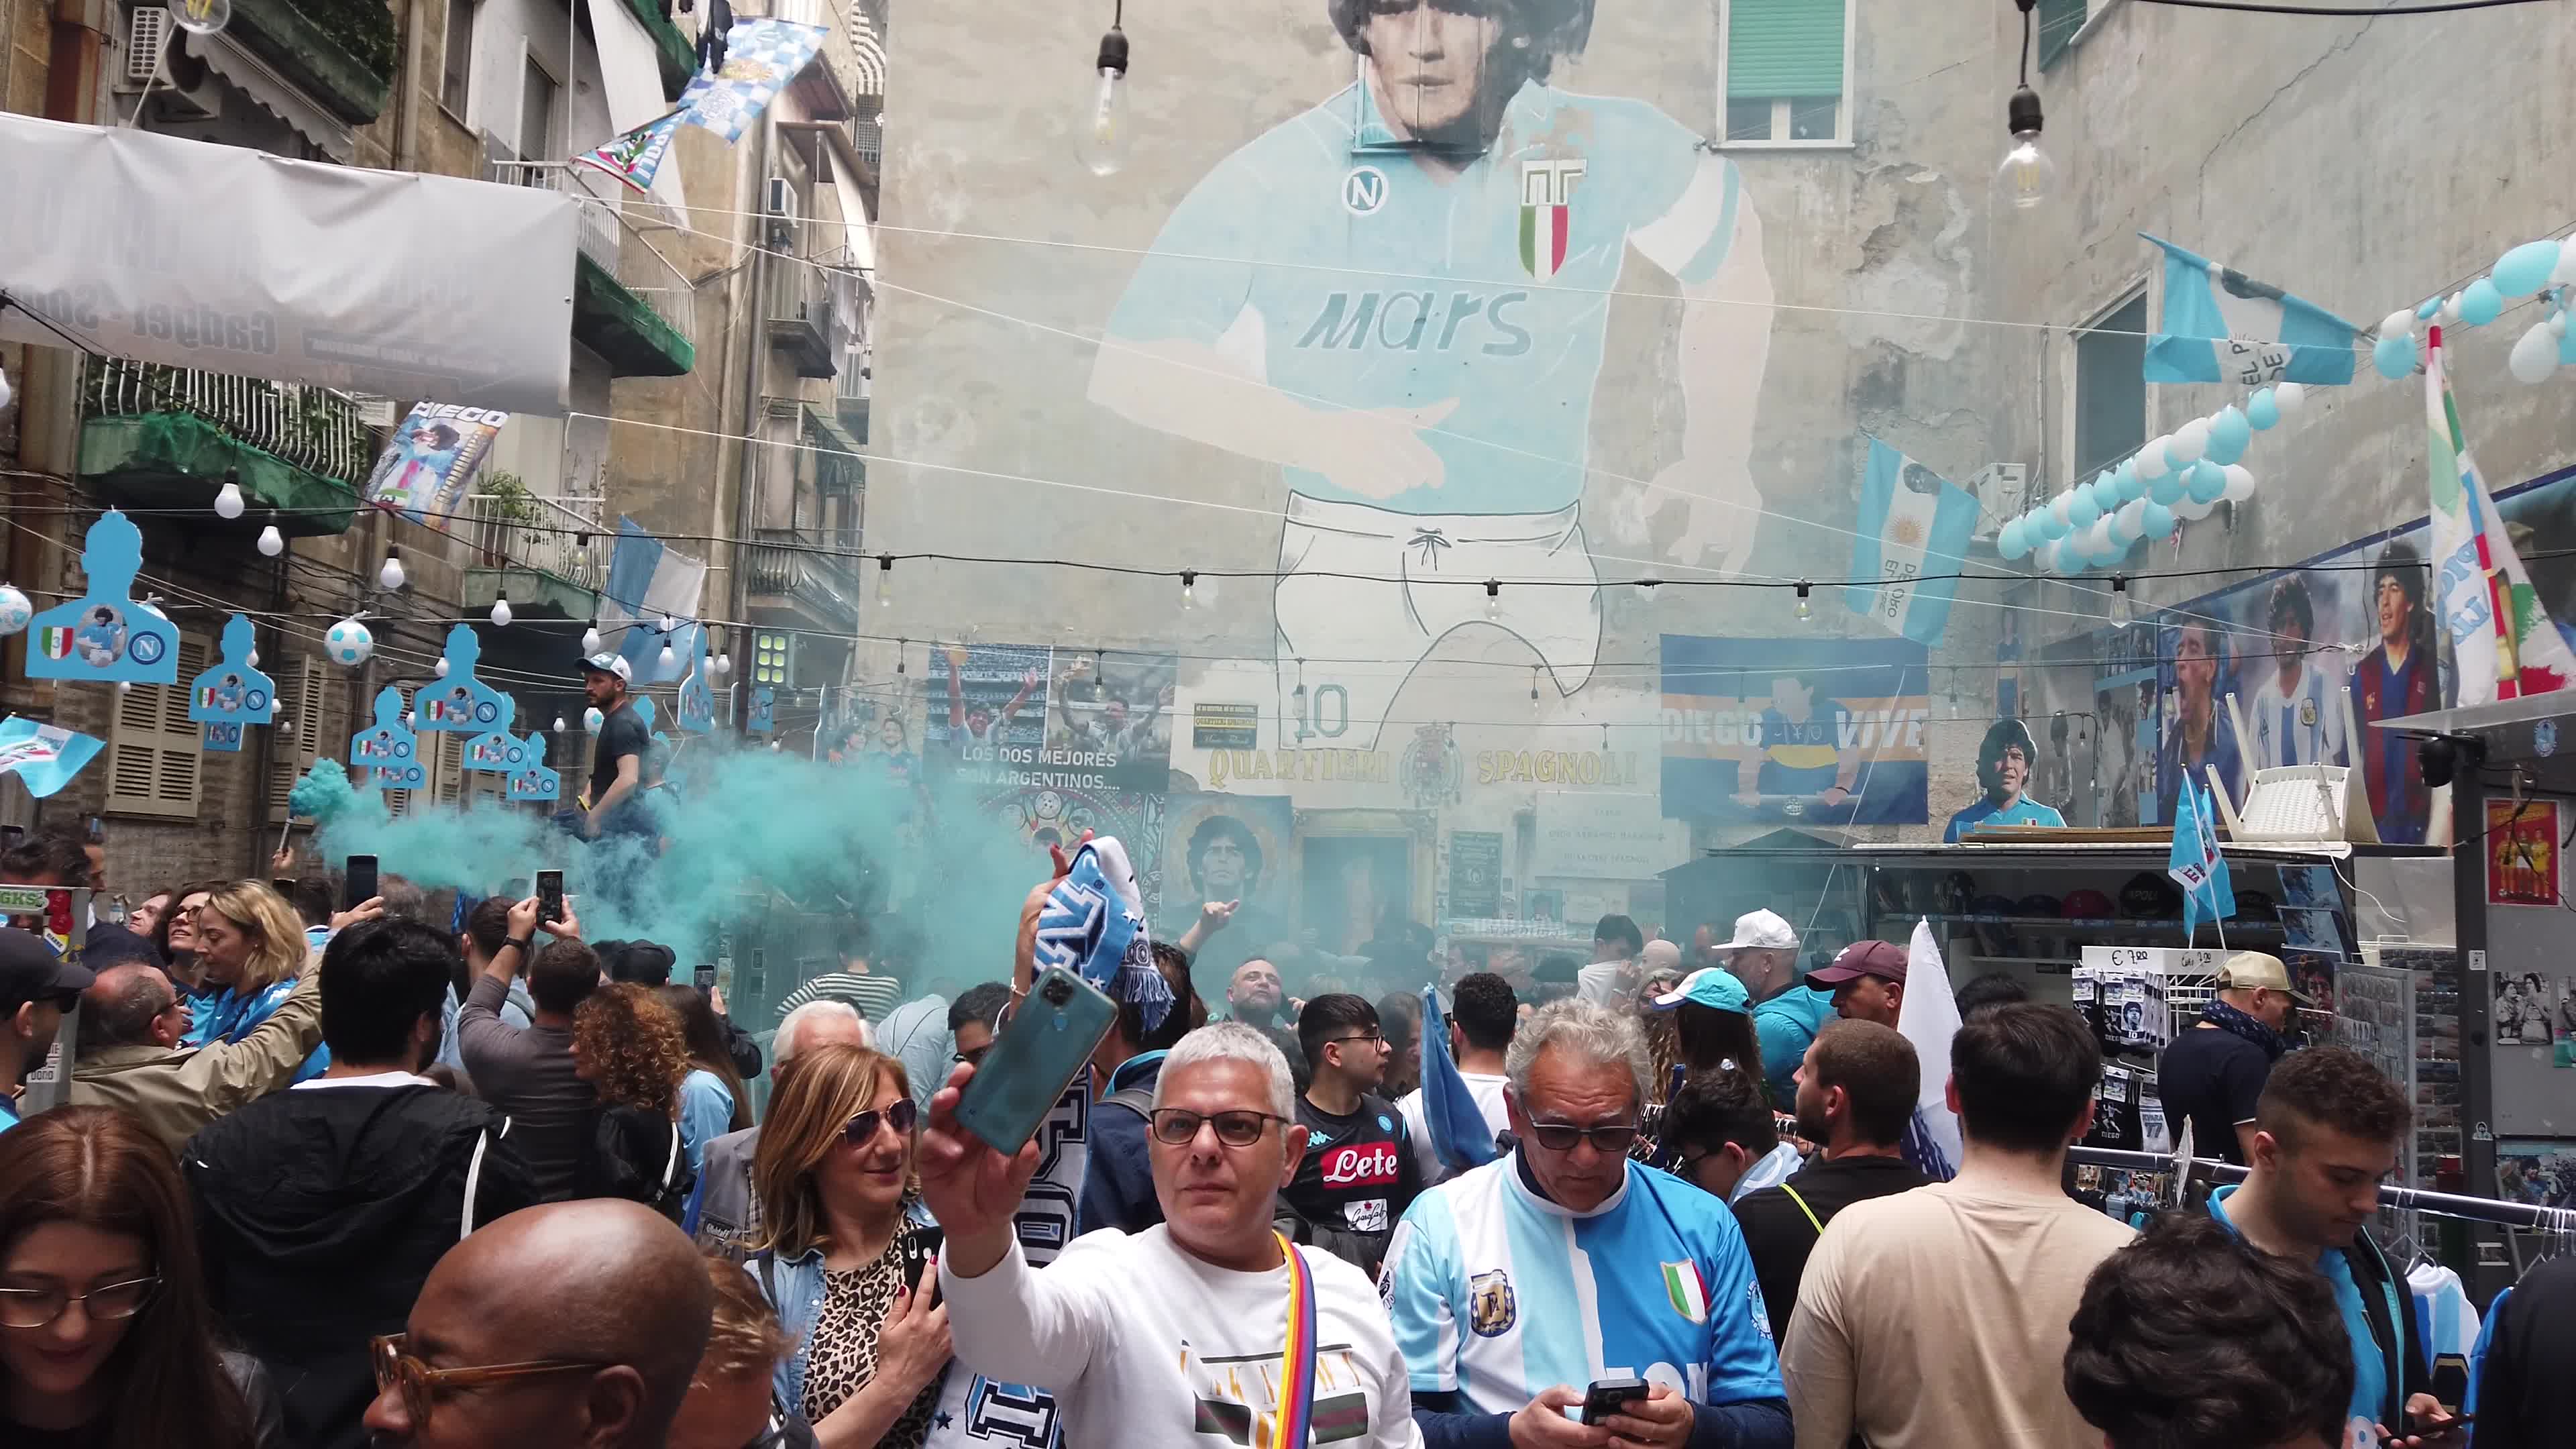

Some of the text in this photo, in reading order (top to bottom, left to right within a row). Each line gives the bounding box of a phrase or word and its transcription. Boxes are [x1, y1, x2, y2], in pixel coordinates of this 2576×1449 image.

[409, 400, 508, 428] DIEGO
[53, 636, 60, 649] 3
[138, 639, 156, 656] N
[1662, 708, 1928, 749] DIEGO VIVE
[962, 746, 1117, 767] LOS DOS MEJORES
[1210, 747, 1631, 790] QUARTIERI SPAGNOLI
[2112, 950, 2123, 966] €
[2128, 1031, 2138, 1039] 10
[2101, 1131, 2121, 1139] DIEGO
[2145, 1123, 2163, 1138] 77
[1323, 1148, 1397, 1183] Lete
